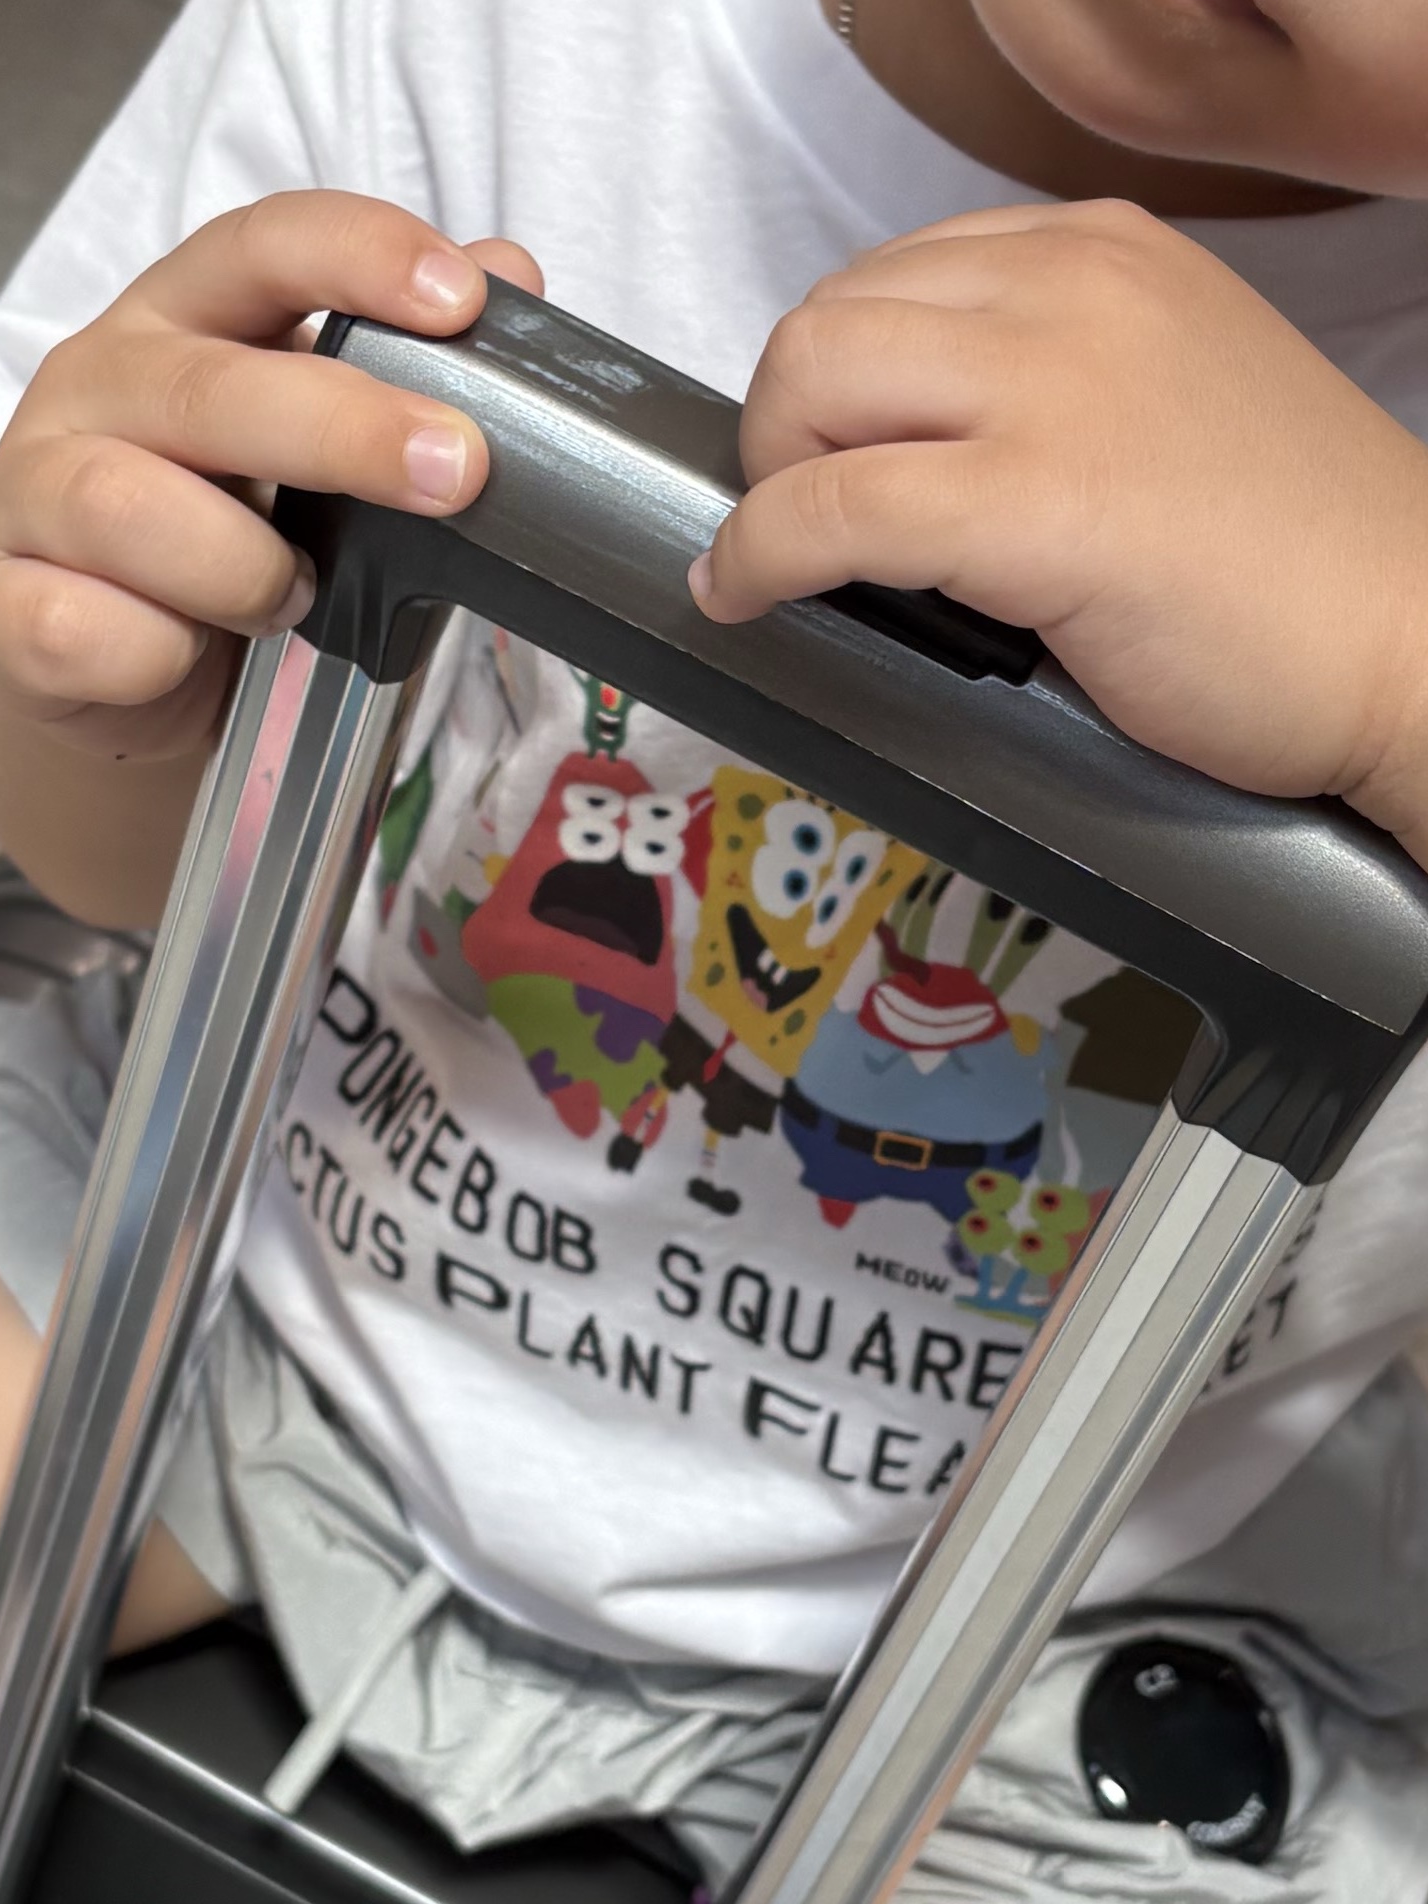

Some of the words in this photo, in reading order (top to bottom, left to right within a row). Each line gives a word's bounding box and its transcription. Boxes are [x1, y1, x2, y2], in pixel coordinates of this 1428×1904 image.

[285, 1120, 406, 1281] CTUS
[435, 1250, 712, 1415] PLANT
[318, 967, 597, 1276] PONGEBOB
[655, 1242, 1024, 1410] SQUARE
[855, 1251, 949, 1293] MEOW
